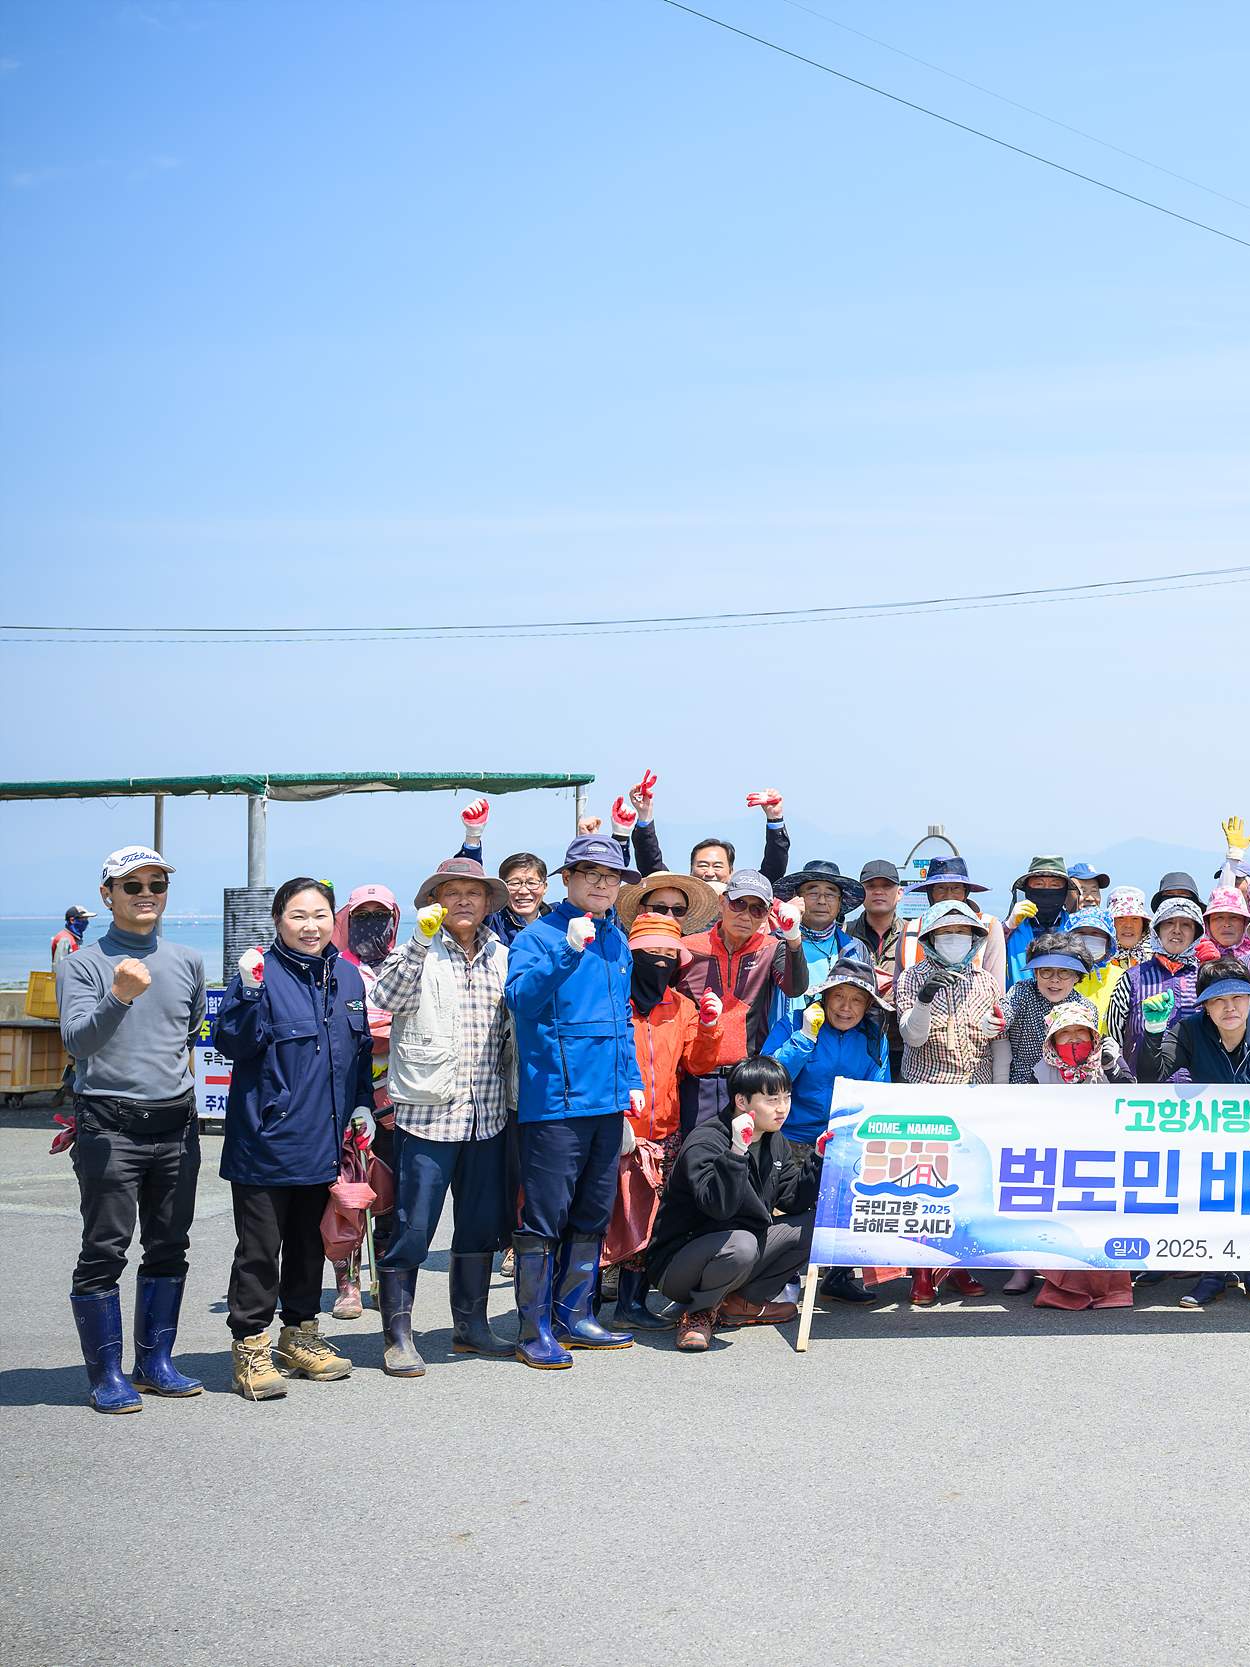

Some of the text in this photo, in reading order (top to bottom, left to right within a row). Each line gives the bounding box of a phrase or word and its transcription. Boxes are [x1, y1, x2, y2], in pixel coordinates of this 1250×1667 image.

[906, 1123, 953, 1136] NAMHAE
[998, 1147, 1181, 1215] 범도민
[855, 1199, 951, 1216] 국민고향 2025
[852, 1218, 952, 1235] 남해로 오시다
[1112, 1240, 1143, 1257] 일시
[1156, 1239, 1214, 1260] 2025.
[1222, 1239, 1241, 1260] 4.
